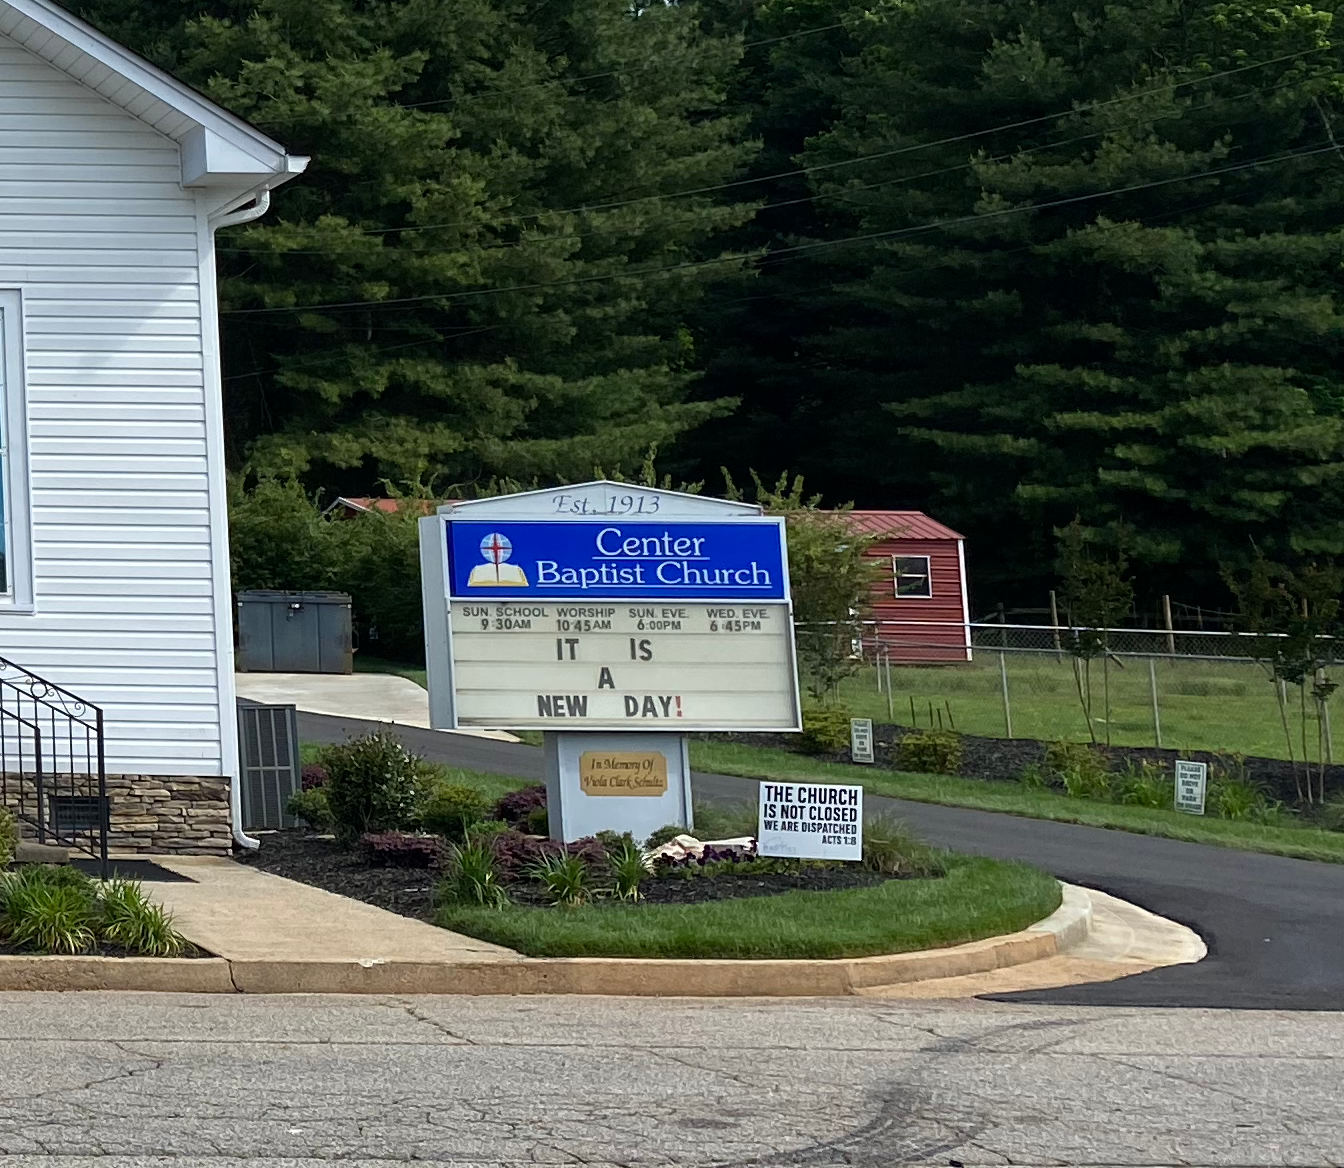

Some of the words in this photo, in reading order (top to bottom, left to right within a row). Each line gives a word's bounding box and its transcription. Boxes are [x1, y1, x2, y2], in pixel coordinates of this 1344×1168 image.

[552, 495, 597, 515] Est.
[609, 495, 660, 514] 1913
[596, 527, 706, 557] Center
[536, 560, 646, 589] Baptist
[656, 560, 772, 585] Church
[462, 606, 492, 617] SUN.
[495, 607, 549, 617] SCHOOL
[556, 607, 616, 618] WORSHIP
[629, 608, 658, 618] SUN.
[661, 608, 689, 619] EVE.
[706, 608, 739, 619] WED.
[742, 608, 770, 619] EVE.
[556, 638, 579, 661] IT
[629, 638, 653, 661] IS
[598, 666, 615, 689] A
[537, 694, 588, 717] NEW
[624, 695, 683, 718] DAY!
[591, 758, 602, 769] In
[603, 756, 641, 775] Memory
[765, 785, 793, 803] THE
[798, 787, 858, 806] CHURCH
[764, 803, 776, 819] IS
[780, 804, 806, 820] NOT
[809, 806, 857, 822] CLOSED
[764, 820, 778, 831] WE
[781, 821, 799, 832] ARE
[801, 822, 857, 835] DISPATCHED
[822, 835, 841, 845] ACTS
[843, 836, 857, 846] 1:8
